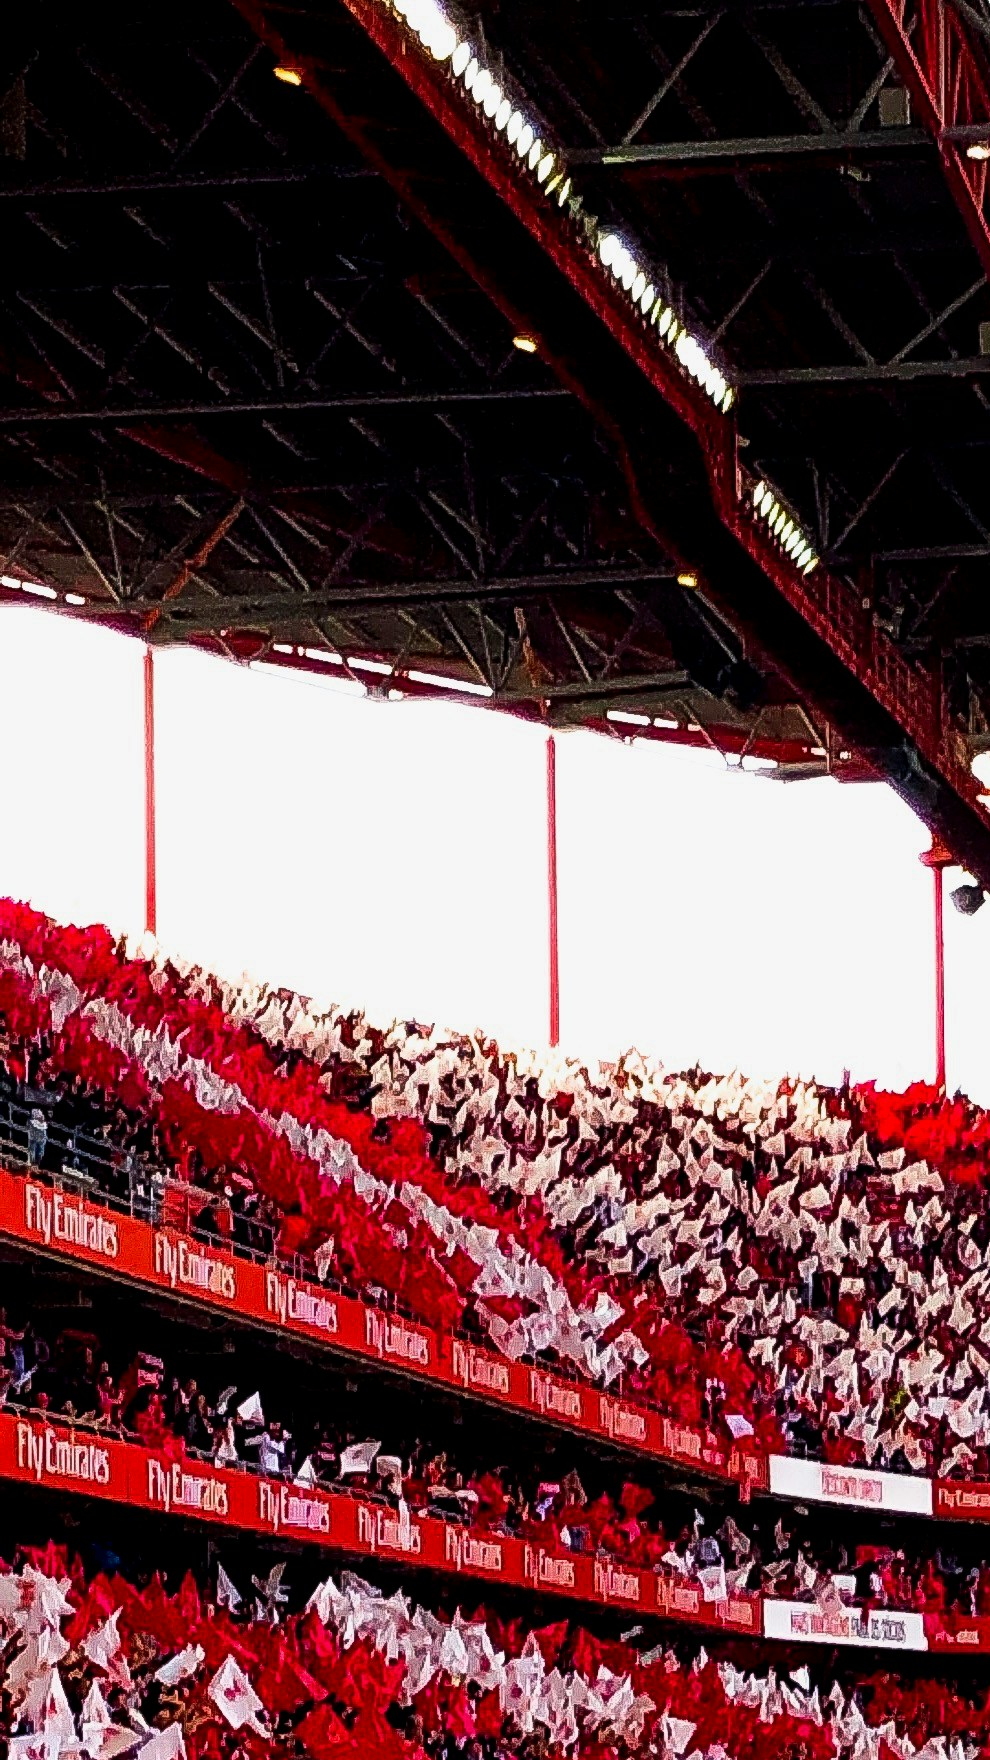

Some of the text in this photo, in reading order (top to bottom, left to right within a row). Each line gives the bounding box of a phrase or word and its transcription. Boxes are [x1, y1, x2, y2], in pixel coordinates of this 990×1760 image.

[25, 1183, 118, 1257] Fly Emirates
[155, 1235, 235, 1298] Fly Emirates
[18, 1421, 110, 1483] Fly Emirates
[148, 1458, 228, 1516] Fly Emirates
